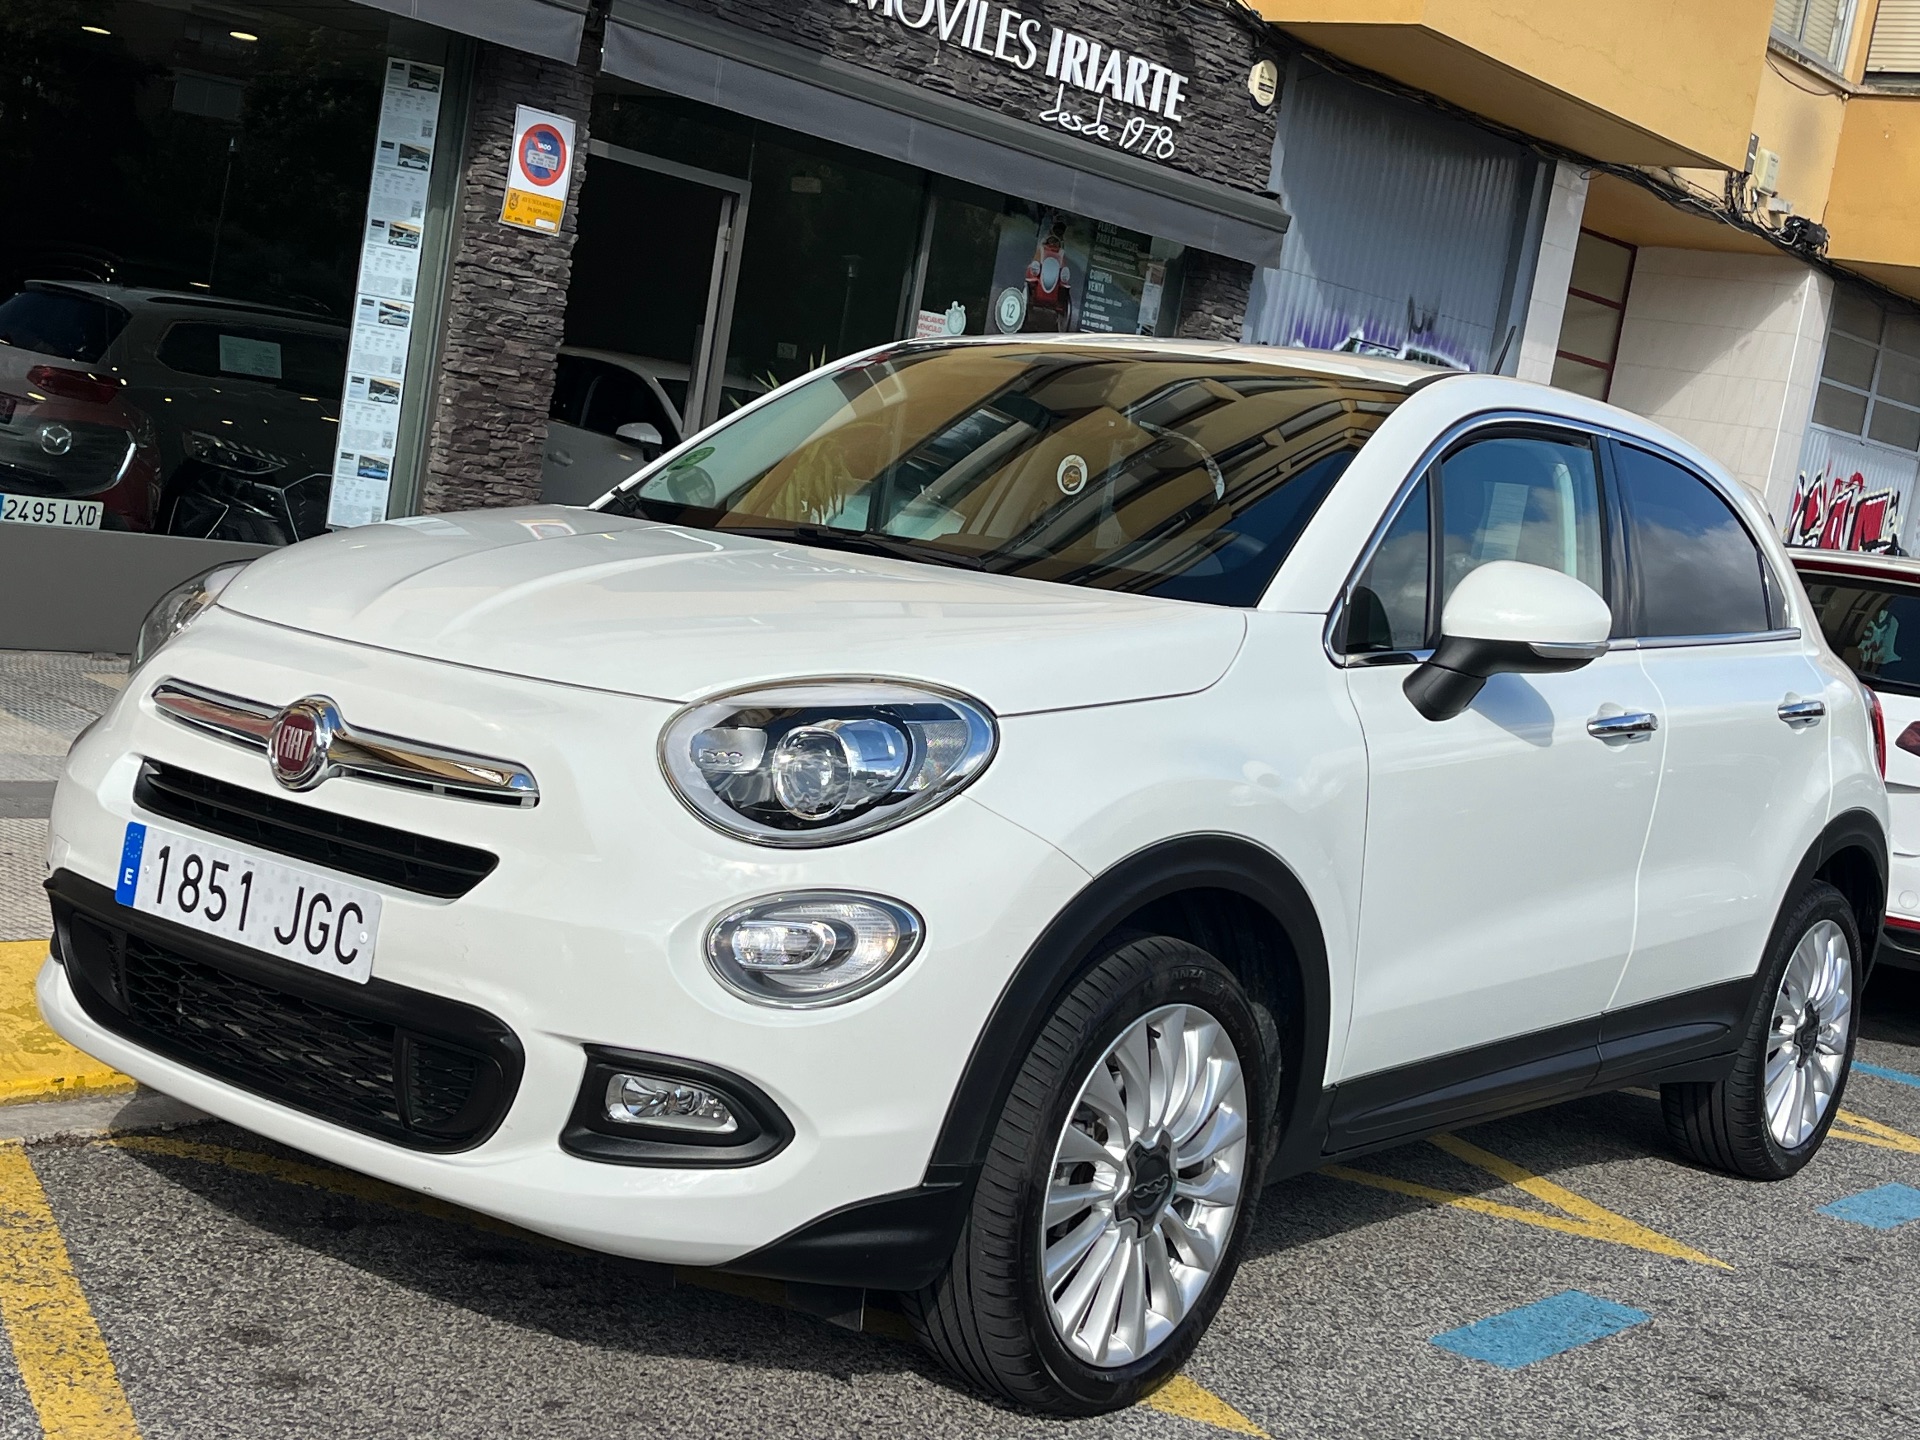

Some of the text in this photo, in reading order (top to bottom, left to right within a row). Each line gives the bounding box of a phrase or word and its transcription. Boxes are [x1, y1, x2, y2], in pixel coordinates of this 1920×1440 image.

[1045, 27, 1189, 122] IRIARTE
[1040, 83, 1175, 159] desde 1978
[537, 142, 552, 151] VADO
[1088, 280, 1105, 294] VENTA
[1089, 269, 1112, 284] COMPRA
[1006, 303, 1016, 318] 12
[4, 499, 97, 526] 2495 LXD
[279, 725, 312, 762] FIAT
[124, 868, 134, 885] E
[157, 845, 363, 965] 1851 JGC
